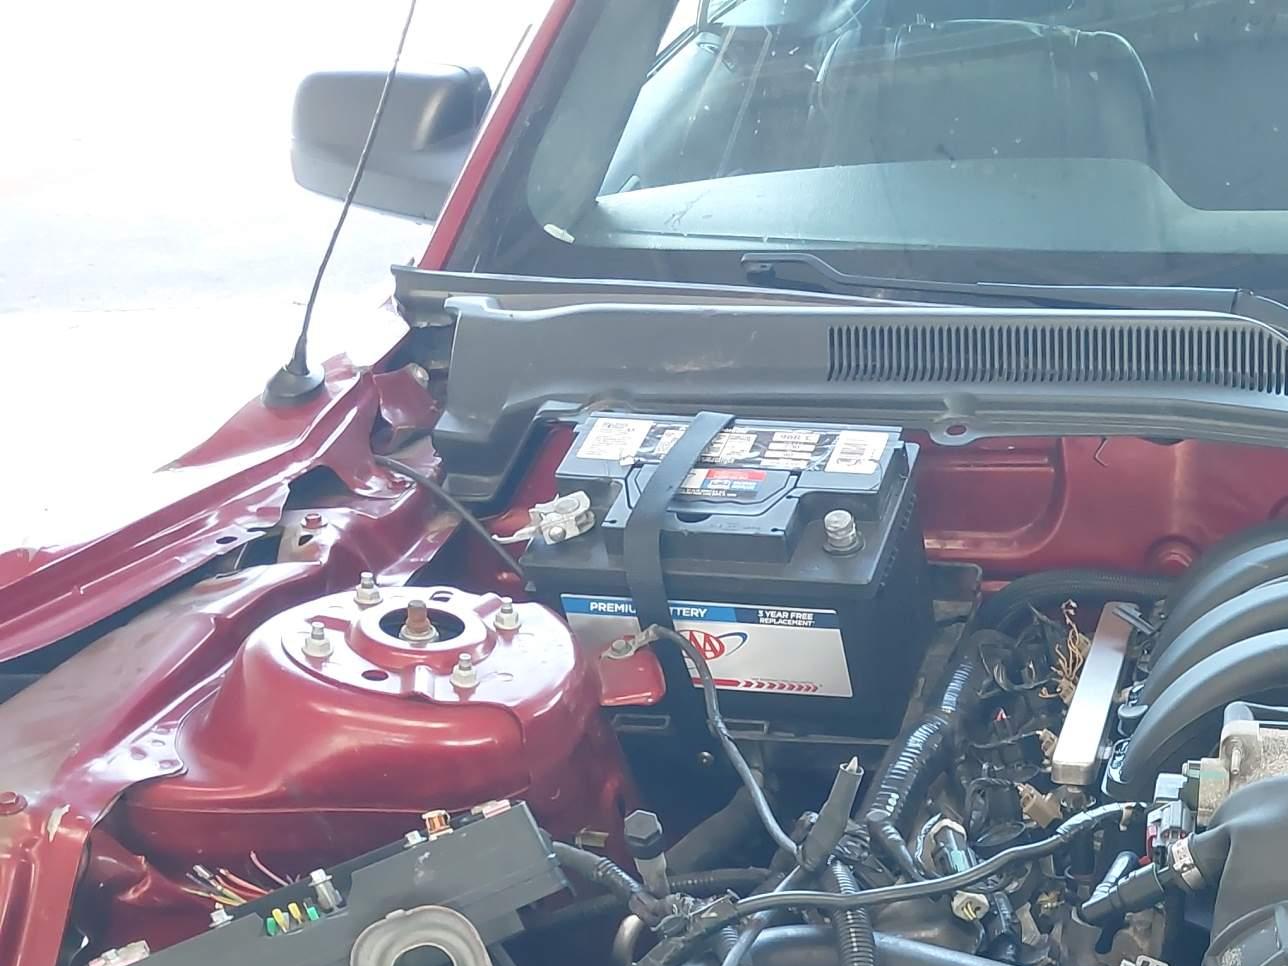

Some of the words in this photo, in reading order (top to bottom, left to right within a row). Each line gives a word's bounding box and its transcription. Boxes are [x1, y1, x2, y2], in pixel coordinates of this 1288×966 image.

[589, 602, 637, 614] PREMIU
[669, 607, 708, 618] TTERY
[765, 610, 789, 619] YEAR
[790, 611, 814, 620] FREE
